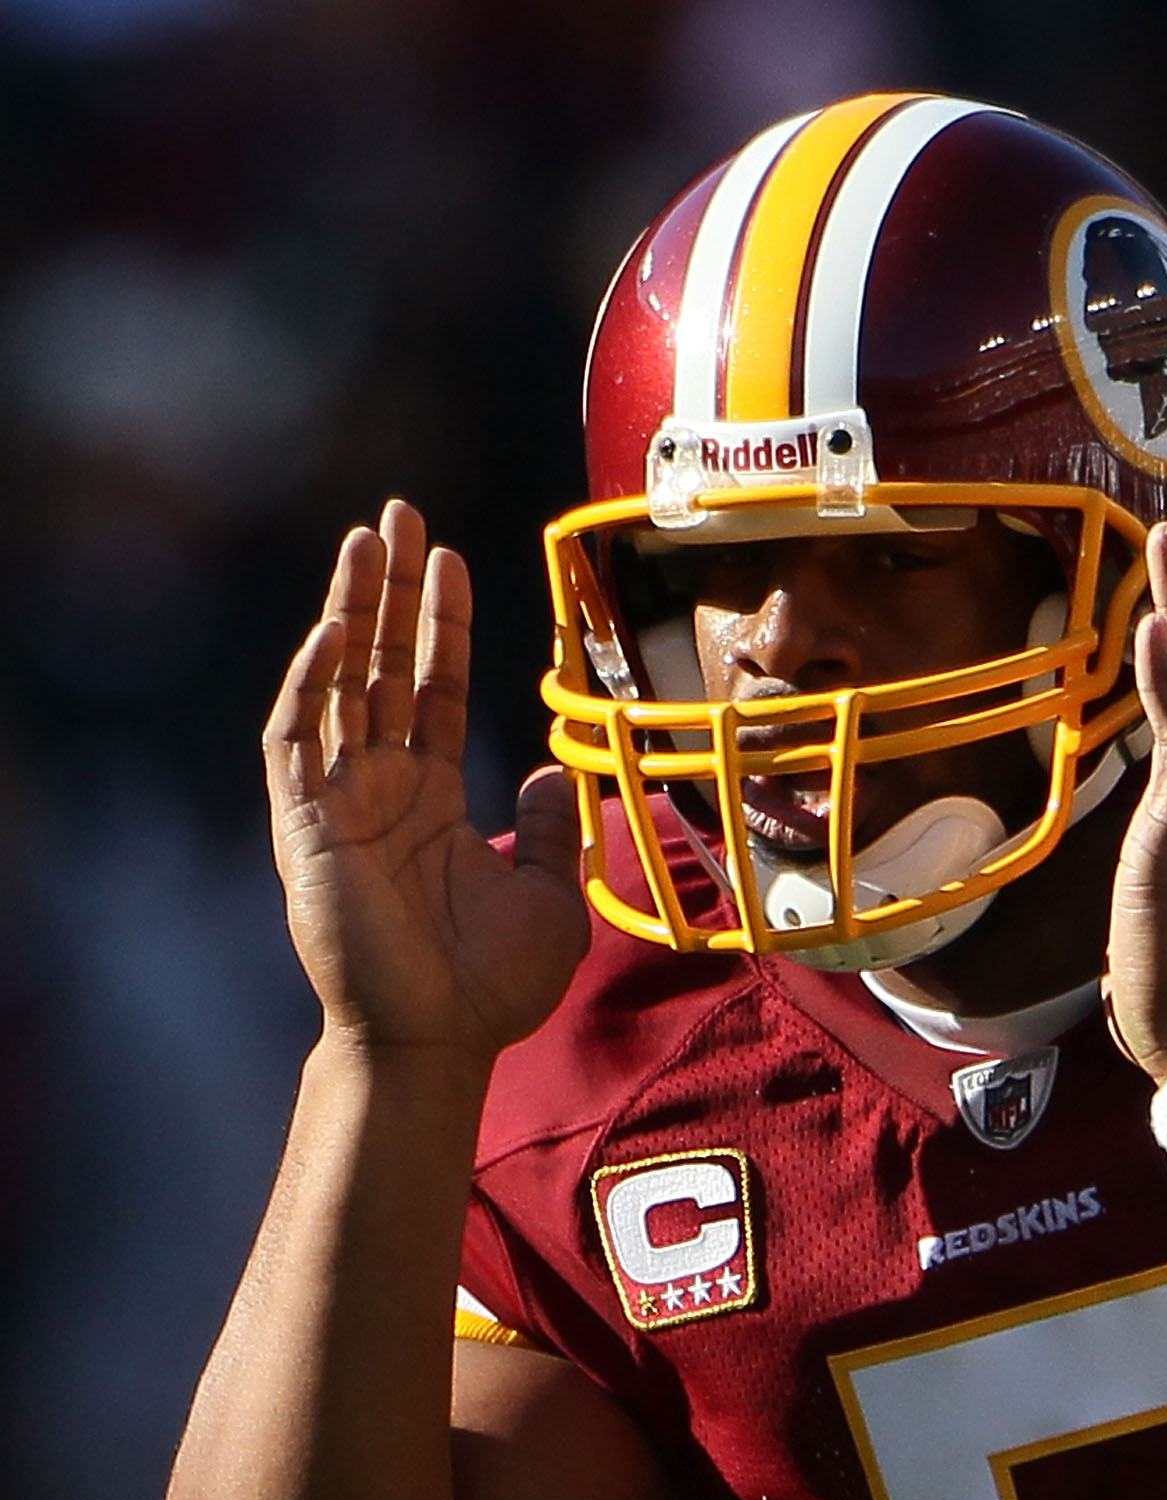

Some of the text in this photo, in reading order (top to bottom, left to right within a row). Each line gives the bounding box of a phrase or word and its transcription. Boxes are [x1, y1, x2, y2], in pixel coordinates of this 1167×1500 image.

[701, 430, 818, 473] Riddell
[606, 1163, 740, 1285] C
[918, 1186, 1102, 1271] REDSKINS
